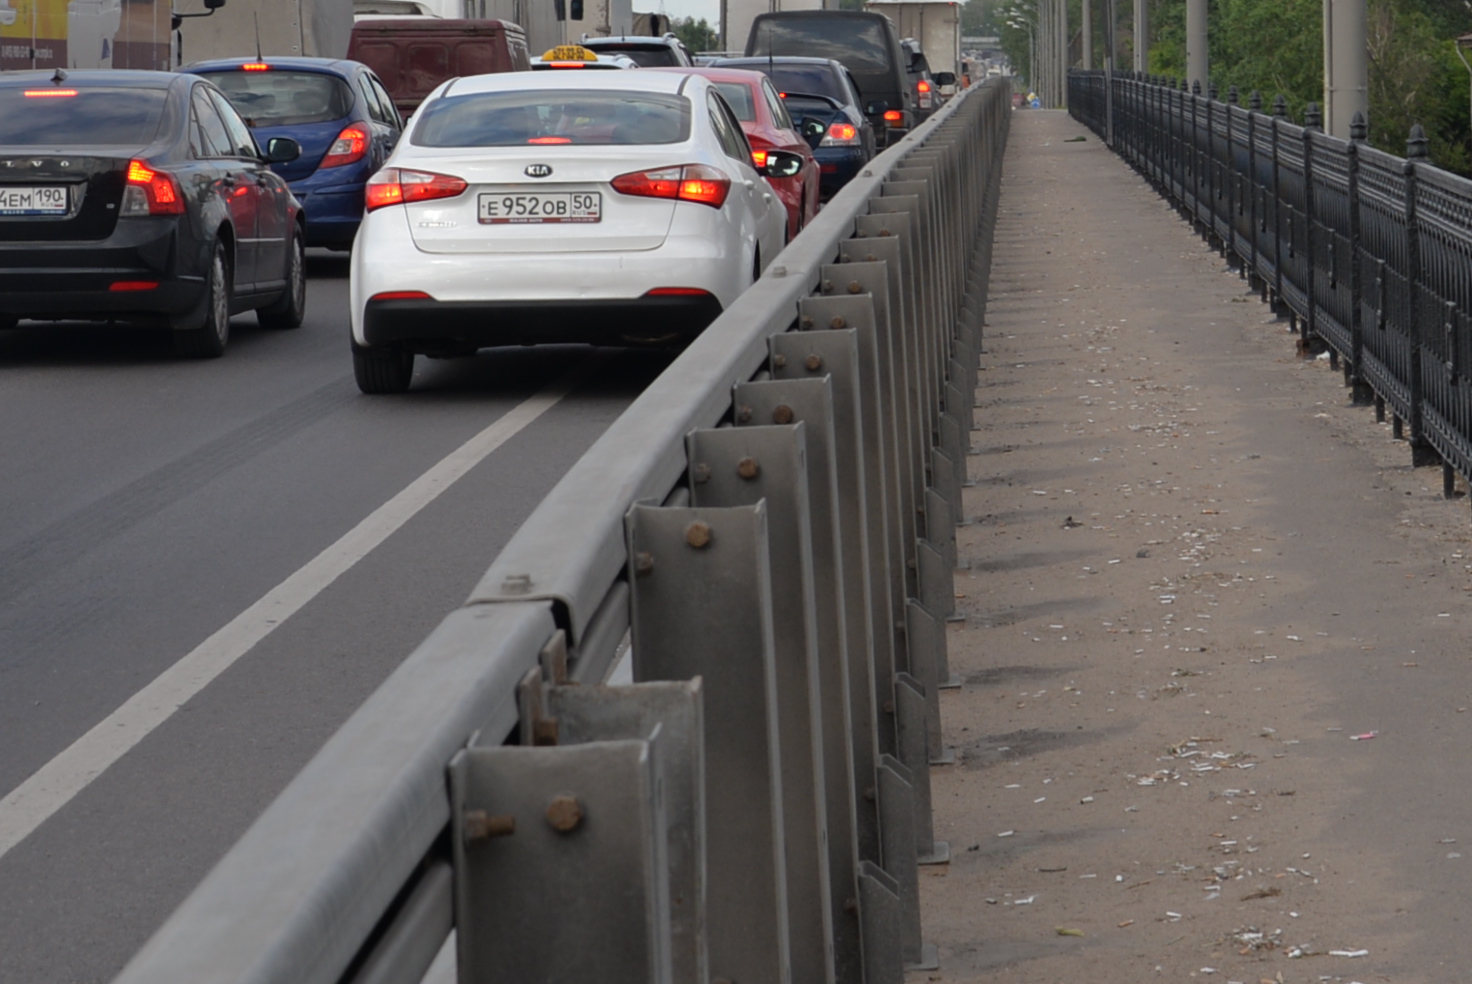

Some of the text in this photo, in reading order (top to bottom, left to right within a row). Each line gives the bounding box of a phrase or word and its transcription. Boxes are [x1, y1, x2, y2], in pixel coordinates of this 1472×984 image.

[527, 165, 549, 176] KIA
[35, 188, 61, 203] 190
[573, 195, 593, 210] 50
